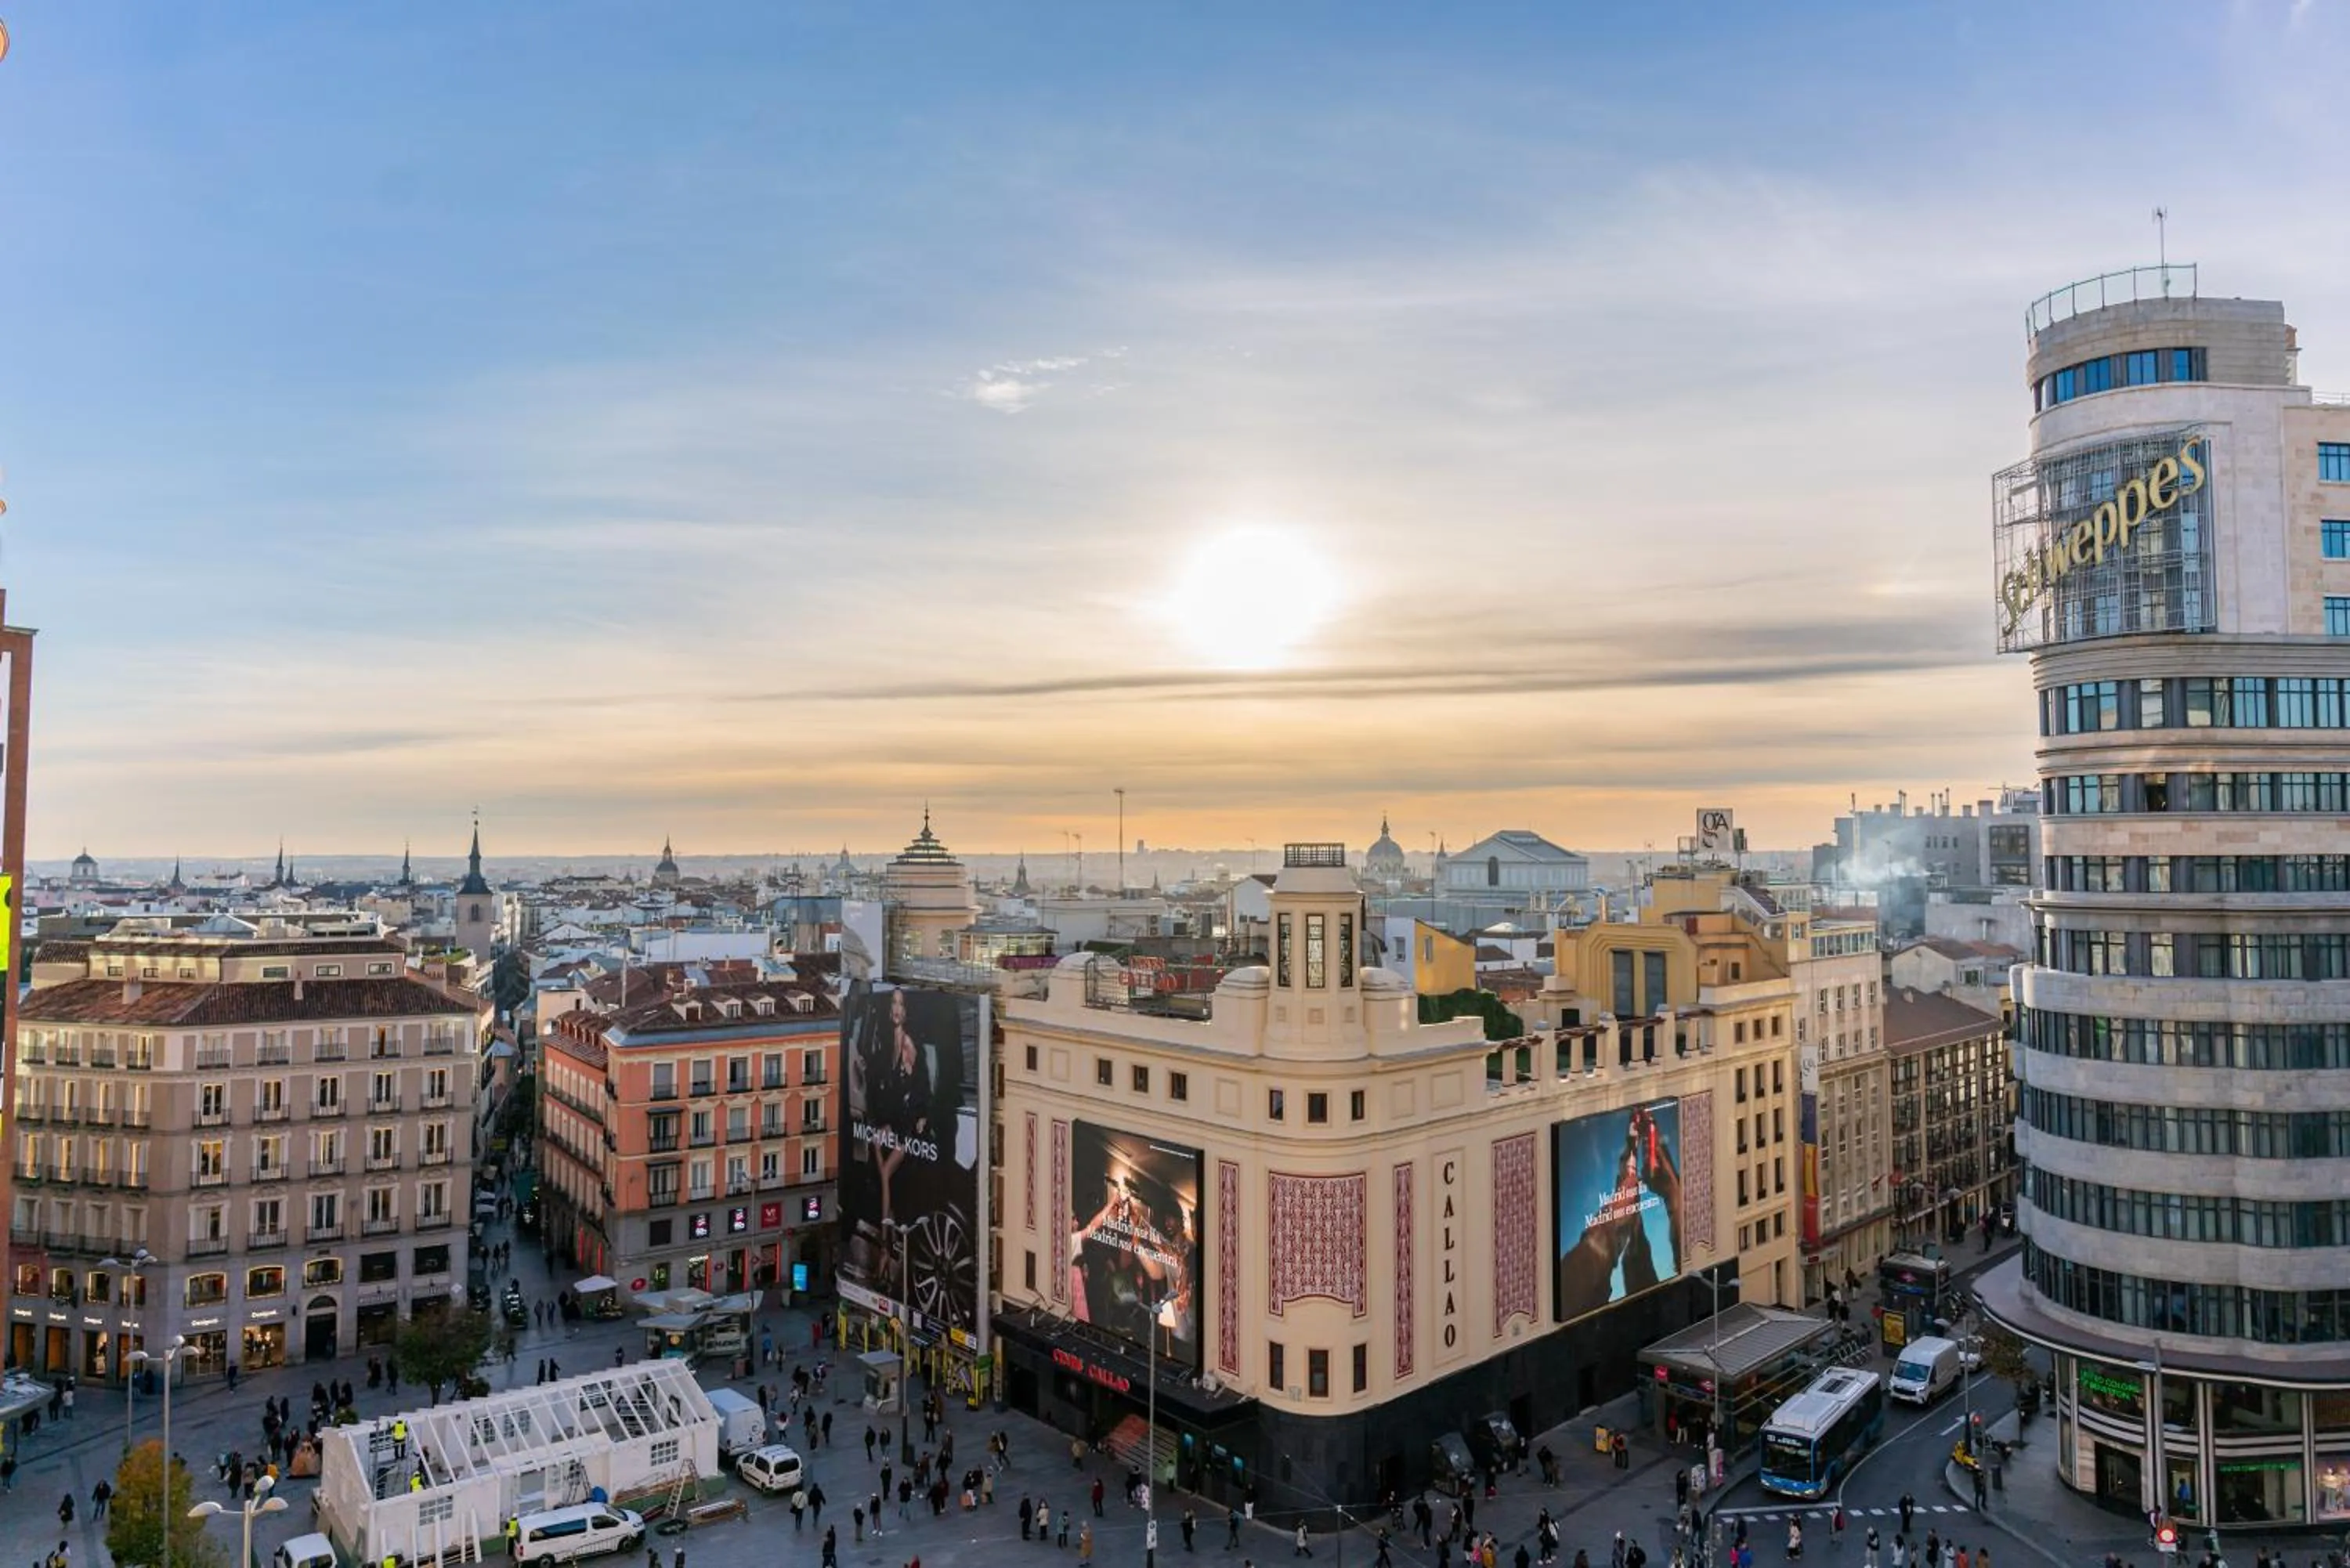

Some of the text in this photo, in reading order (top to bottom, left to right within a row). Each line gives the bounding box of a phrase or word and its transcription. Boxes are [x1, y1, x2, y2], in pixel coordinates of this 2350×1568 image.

[2001, 435, 2204, 638] Schweppes
[852, 1121, 938, 1162] MICHAEL KORS
[1443, 1161, 1456, 1348] CALLAO
